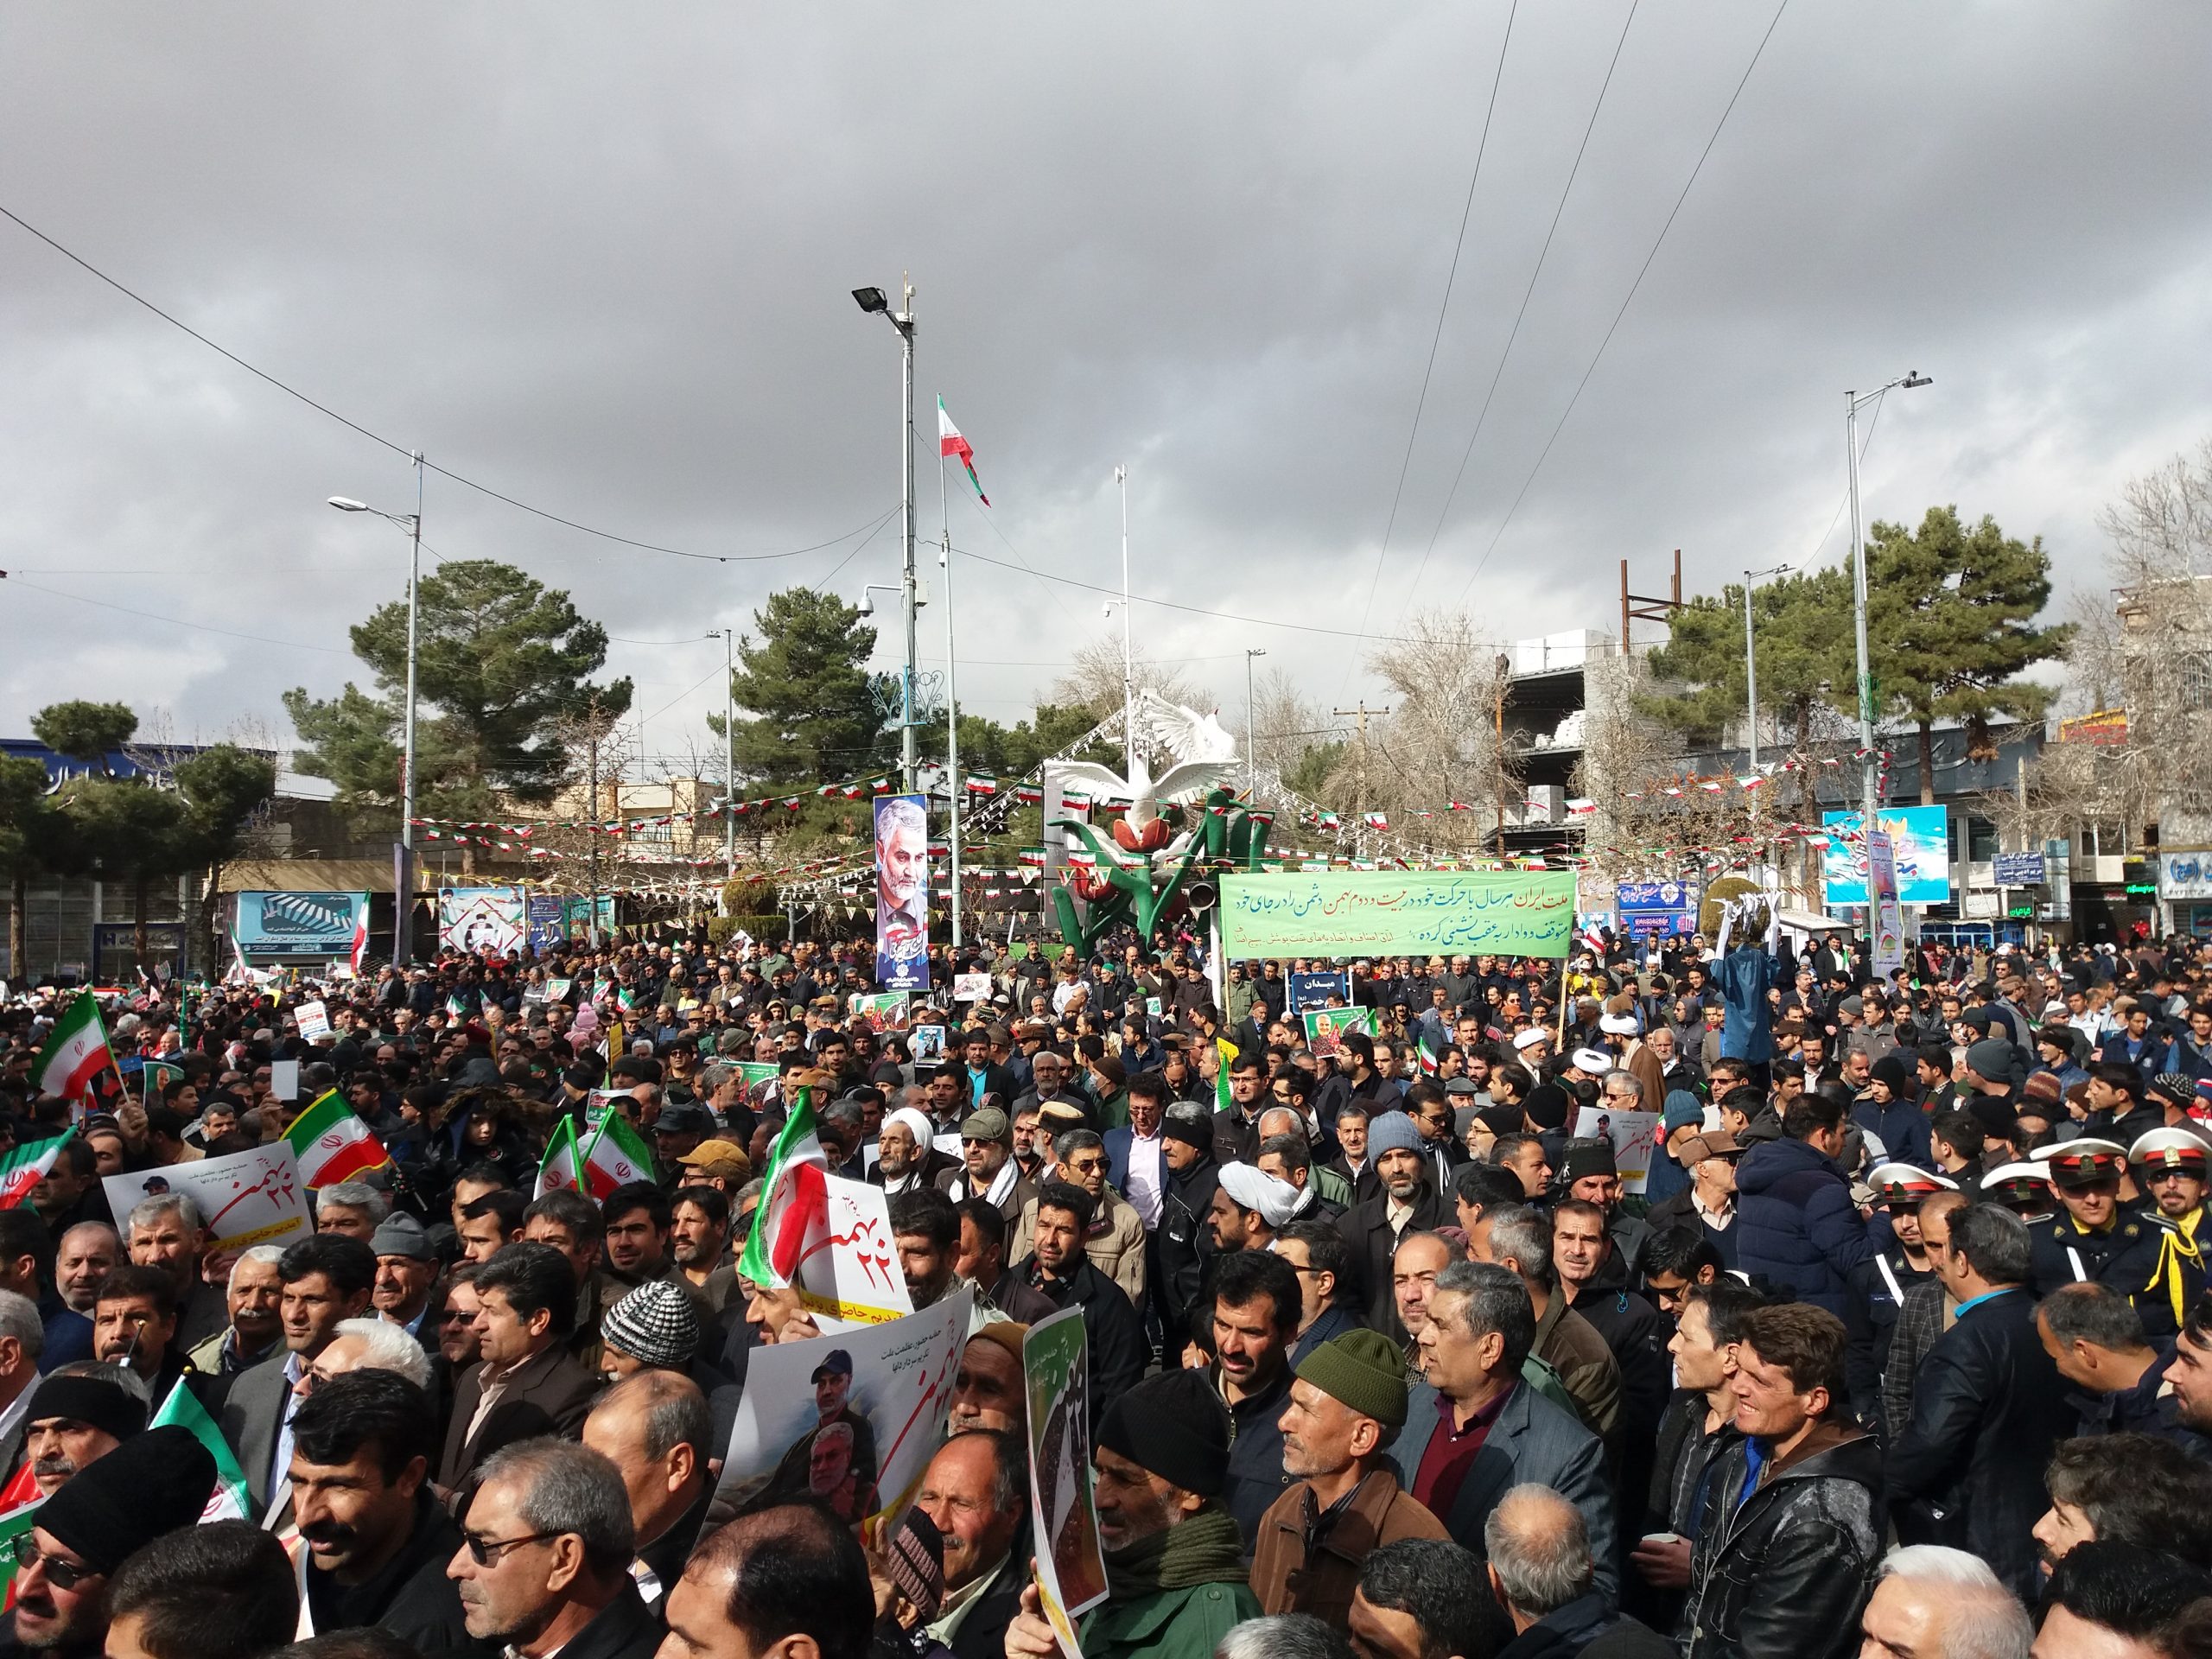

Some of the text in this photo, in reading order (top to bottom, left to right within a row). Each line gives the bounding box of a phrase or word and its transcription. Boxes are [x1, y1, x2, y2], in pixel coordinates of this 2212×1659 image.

[1236, 888, 1250, 909] خود
[1250, 893, 1274, 914] جای
[1294, 883, 1323, 917] دشمن
[1323, 889, 1352, 916] بهمن
[1376, 889, 1408, 912] بیست
[1417, 887, 1434, 907] خود
[1434, 879, 1466, 906] حرکت
[1468, 889, 1474, 910] با
[1514, 887, 1545, 911] ایران
[1541, 893, 1568, 909] ملت
[1535, 920, 1568, 941] متوقف
[1304, 978, 1336, 990] میدان
[207, 1160, 296, 1233] ۲۲ بهمن
[799, 1217, 895, 1294] ۲۲ بهمن
[825, 1304, 868, 1319] حاضری
[1065, 1397, 1083, 1456] ۲۲
